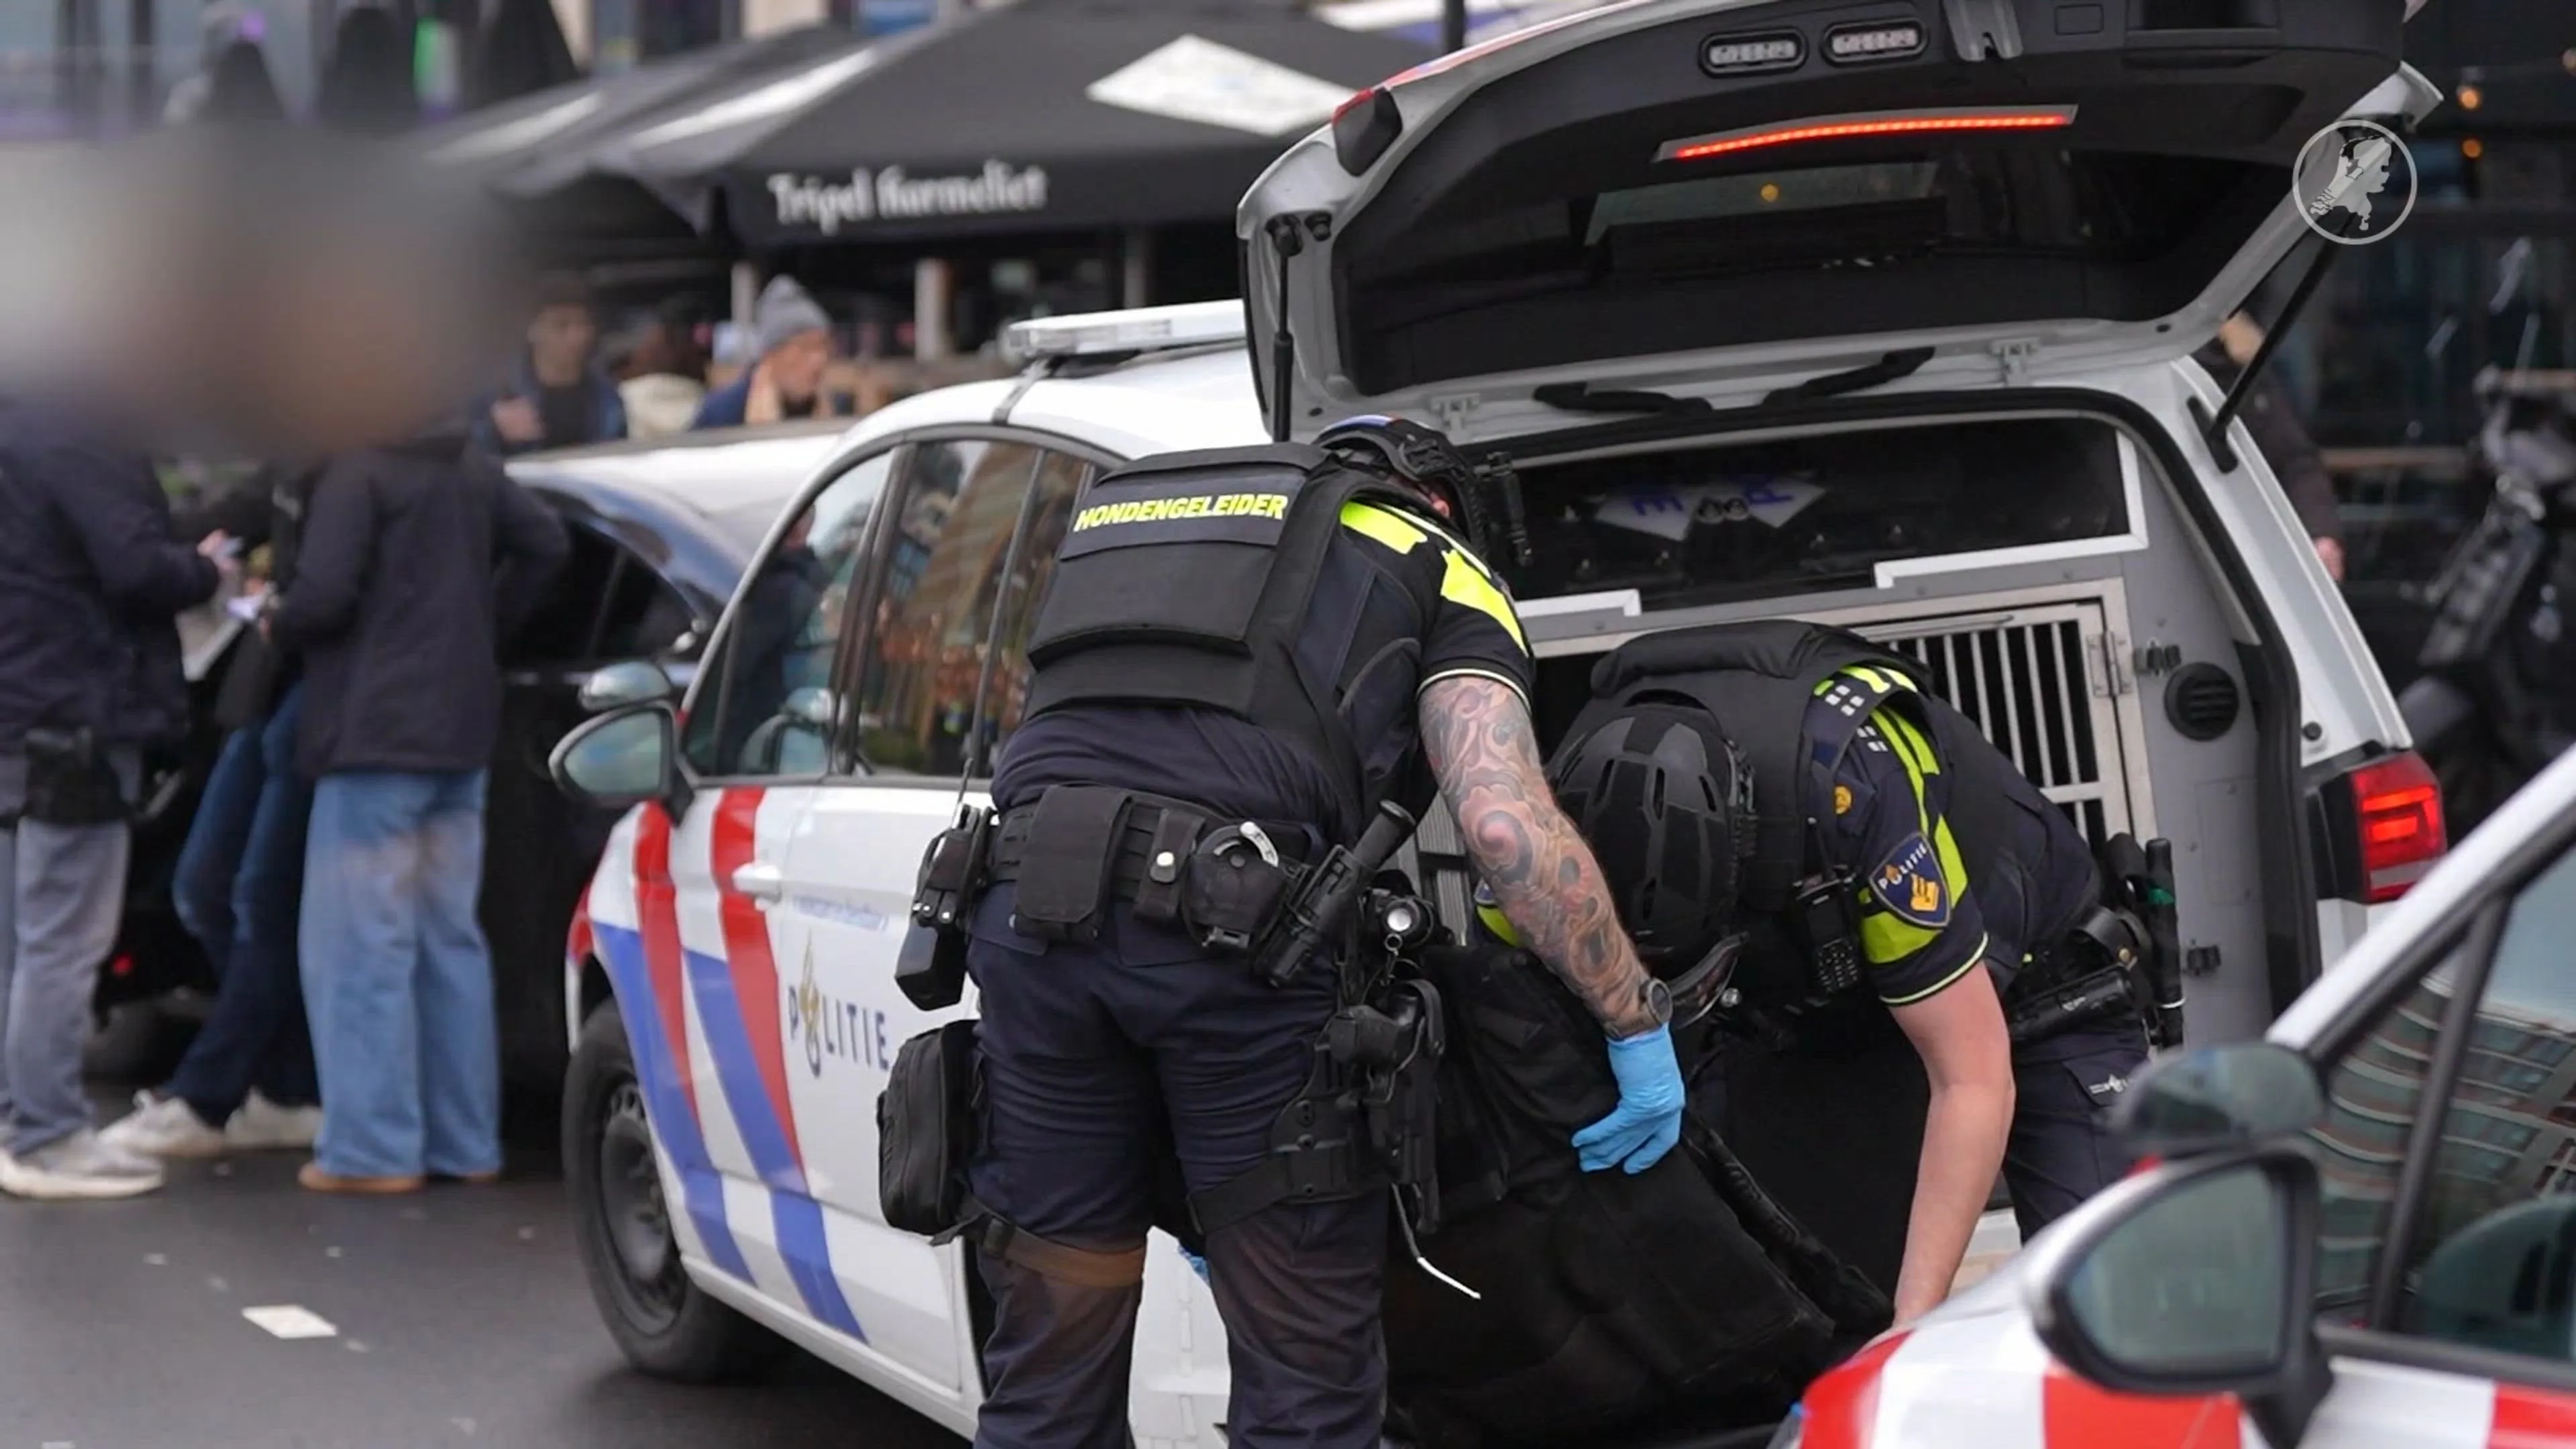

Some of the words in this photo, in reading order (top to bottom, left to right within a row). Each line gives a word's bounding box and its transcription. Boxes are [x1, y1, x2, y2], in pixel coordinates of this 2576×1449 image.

[768, 167, 871, 235] Tripel
[1073, 494, 1288, 532] HONDENGELEIDER
[788, 985, 890, 1077] POLITIE
